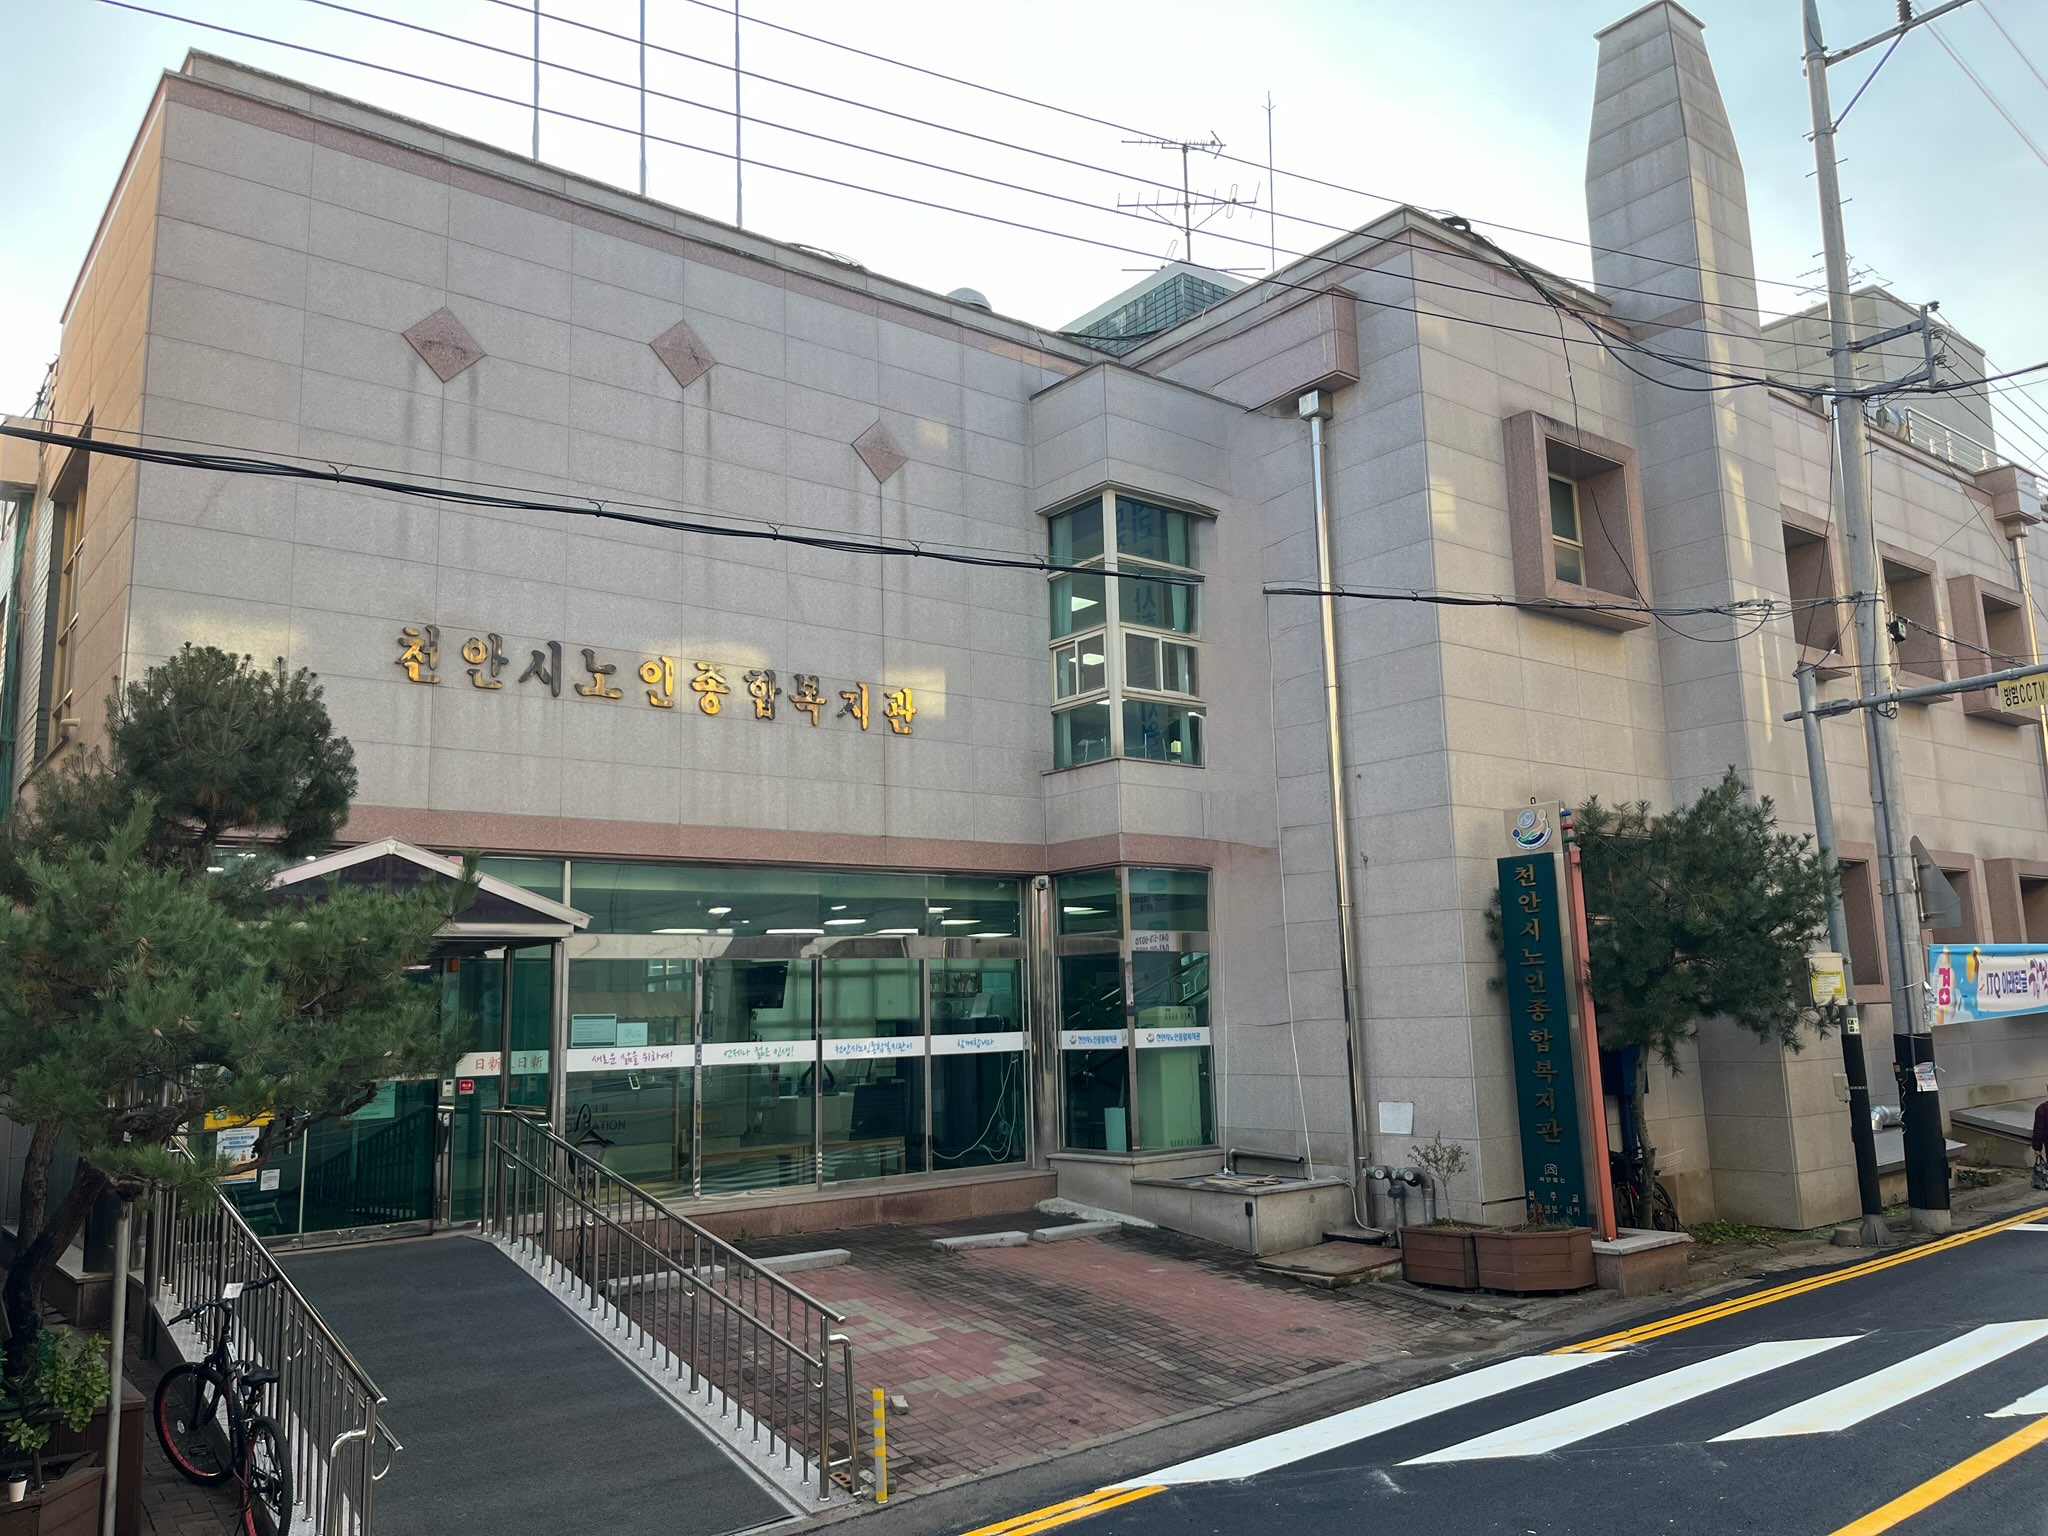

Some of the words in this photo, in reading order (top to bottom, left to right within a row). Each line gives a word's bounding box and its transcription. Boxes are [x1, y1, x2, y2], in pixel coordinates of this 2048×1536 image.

[397, 624, 918, 735] 천안시노인종합복지관
[1986, 972, 2001, 999] ITQ
[1515, 863, 1563, 1144] 천안시노인종합복지관
[592, 1052, 617, 1065] 새로운
[620, 1050, 639, 1066] 삶을
[642, 1050, 674, 1063] 위하여!
[723, 1048, 751, 1058] 언제나
[754, 1046, 771, 1060] 젊은
[773, 1045, 795, 1057] 인생!
[834, 1040, 913, 1055] 천안시노인종합복지관이
